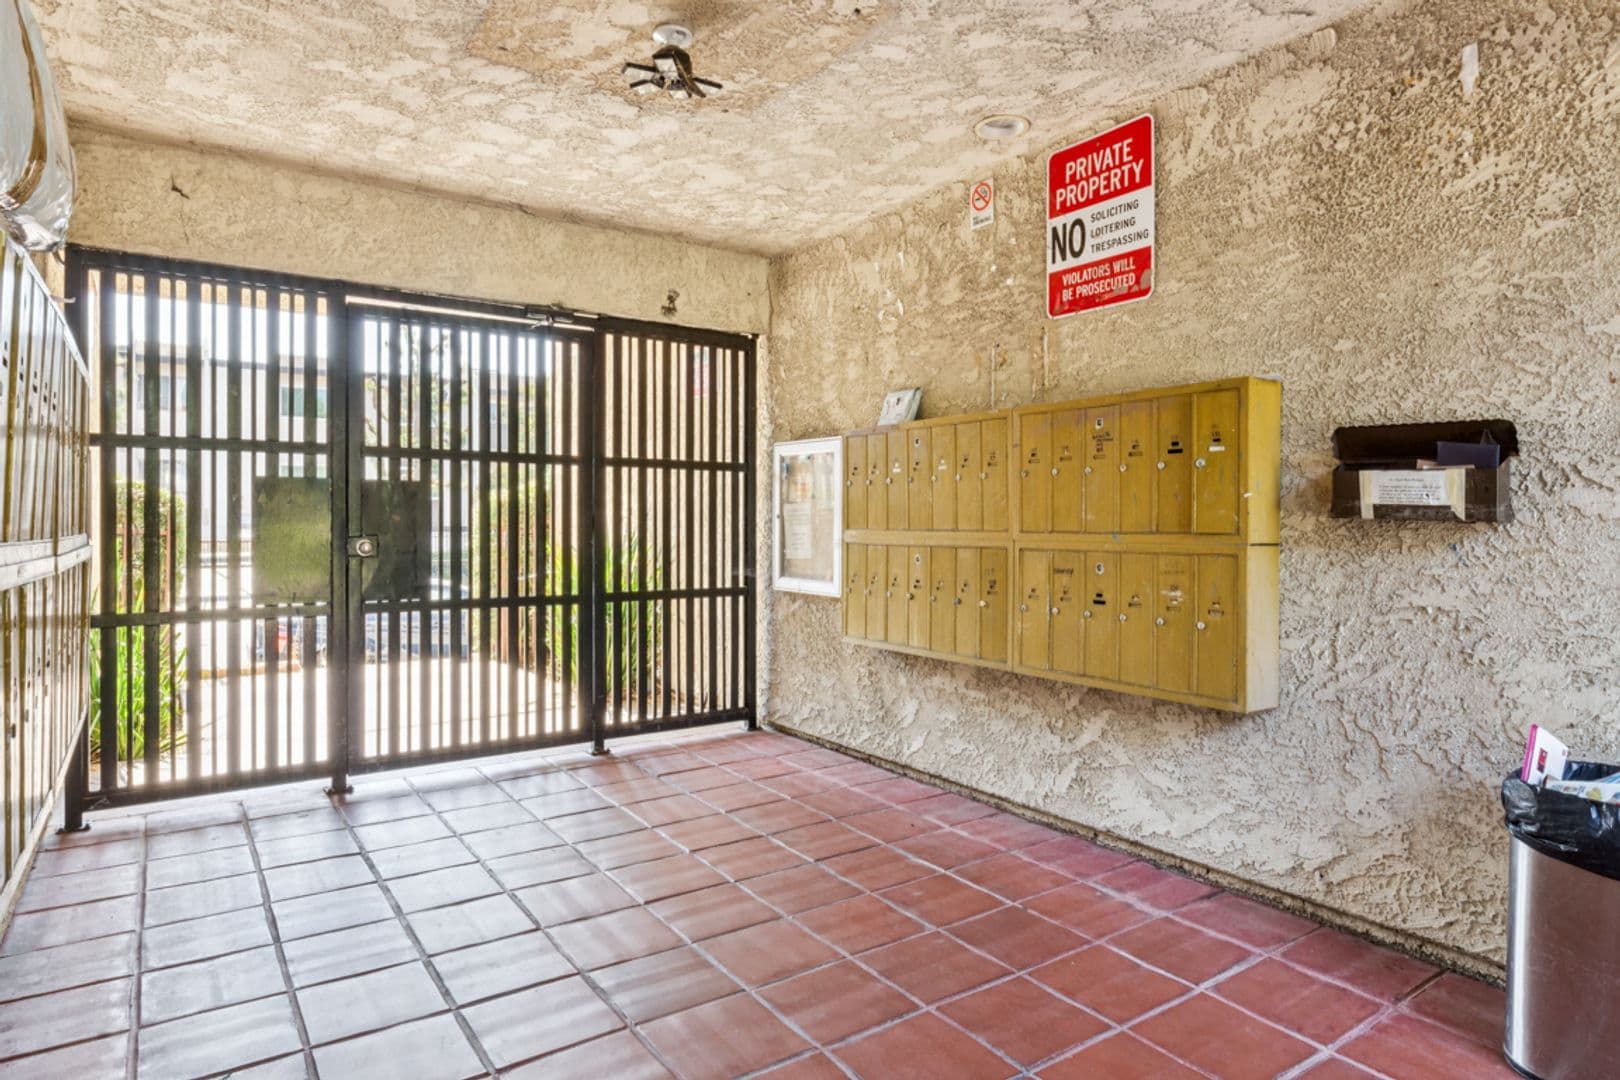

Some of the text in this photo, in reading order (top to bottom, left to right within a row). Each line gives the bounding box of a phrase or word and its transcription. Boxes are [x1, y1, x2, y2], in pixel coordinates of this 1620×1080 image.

[1065, 138, 1133, 184] PRIVATE
[1056, 159, 1144, 210] PROPERTY
[1090, 199, 1139, 223] SOLICITING
[1051, 217, 1086, 265] NO
[1090, 217, 1136, 239] LOITERING
[1090, 230, 1149, 254] TRESPASSING
[1062, 256, 1135, 286] VIOLATORS WILL
[1062, 273, 1135, 302] BE PROSECUTED
